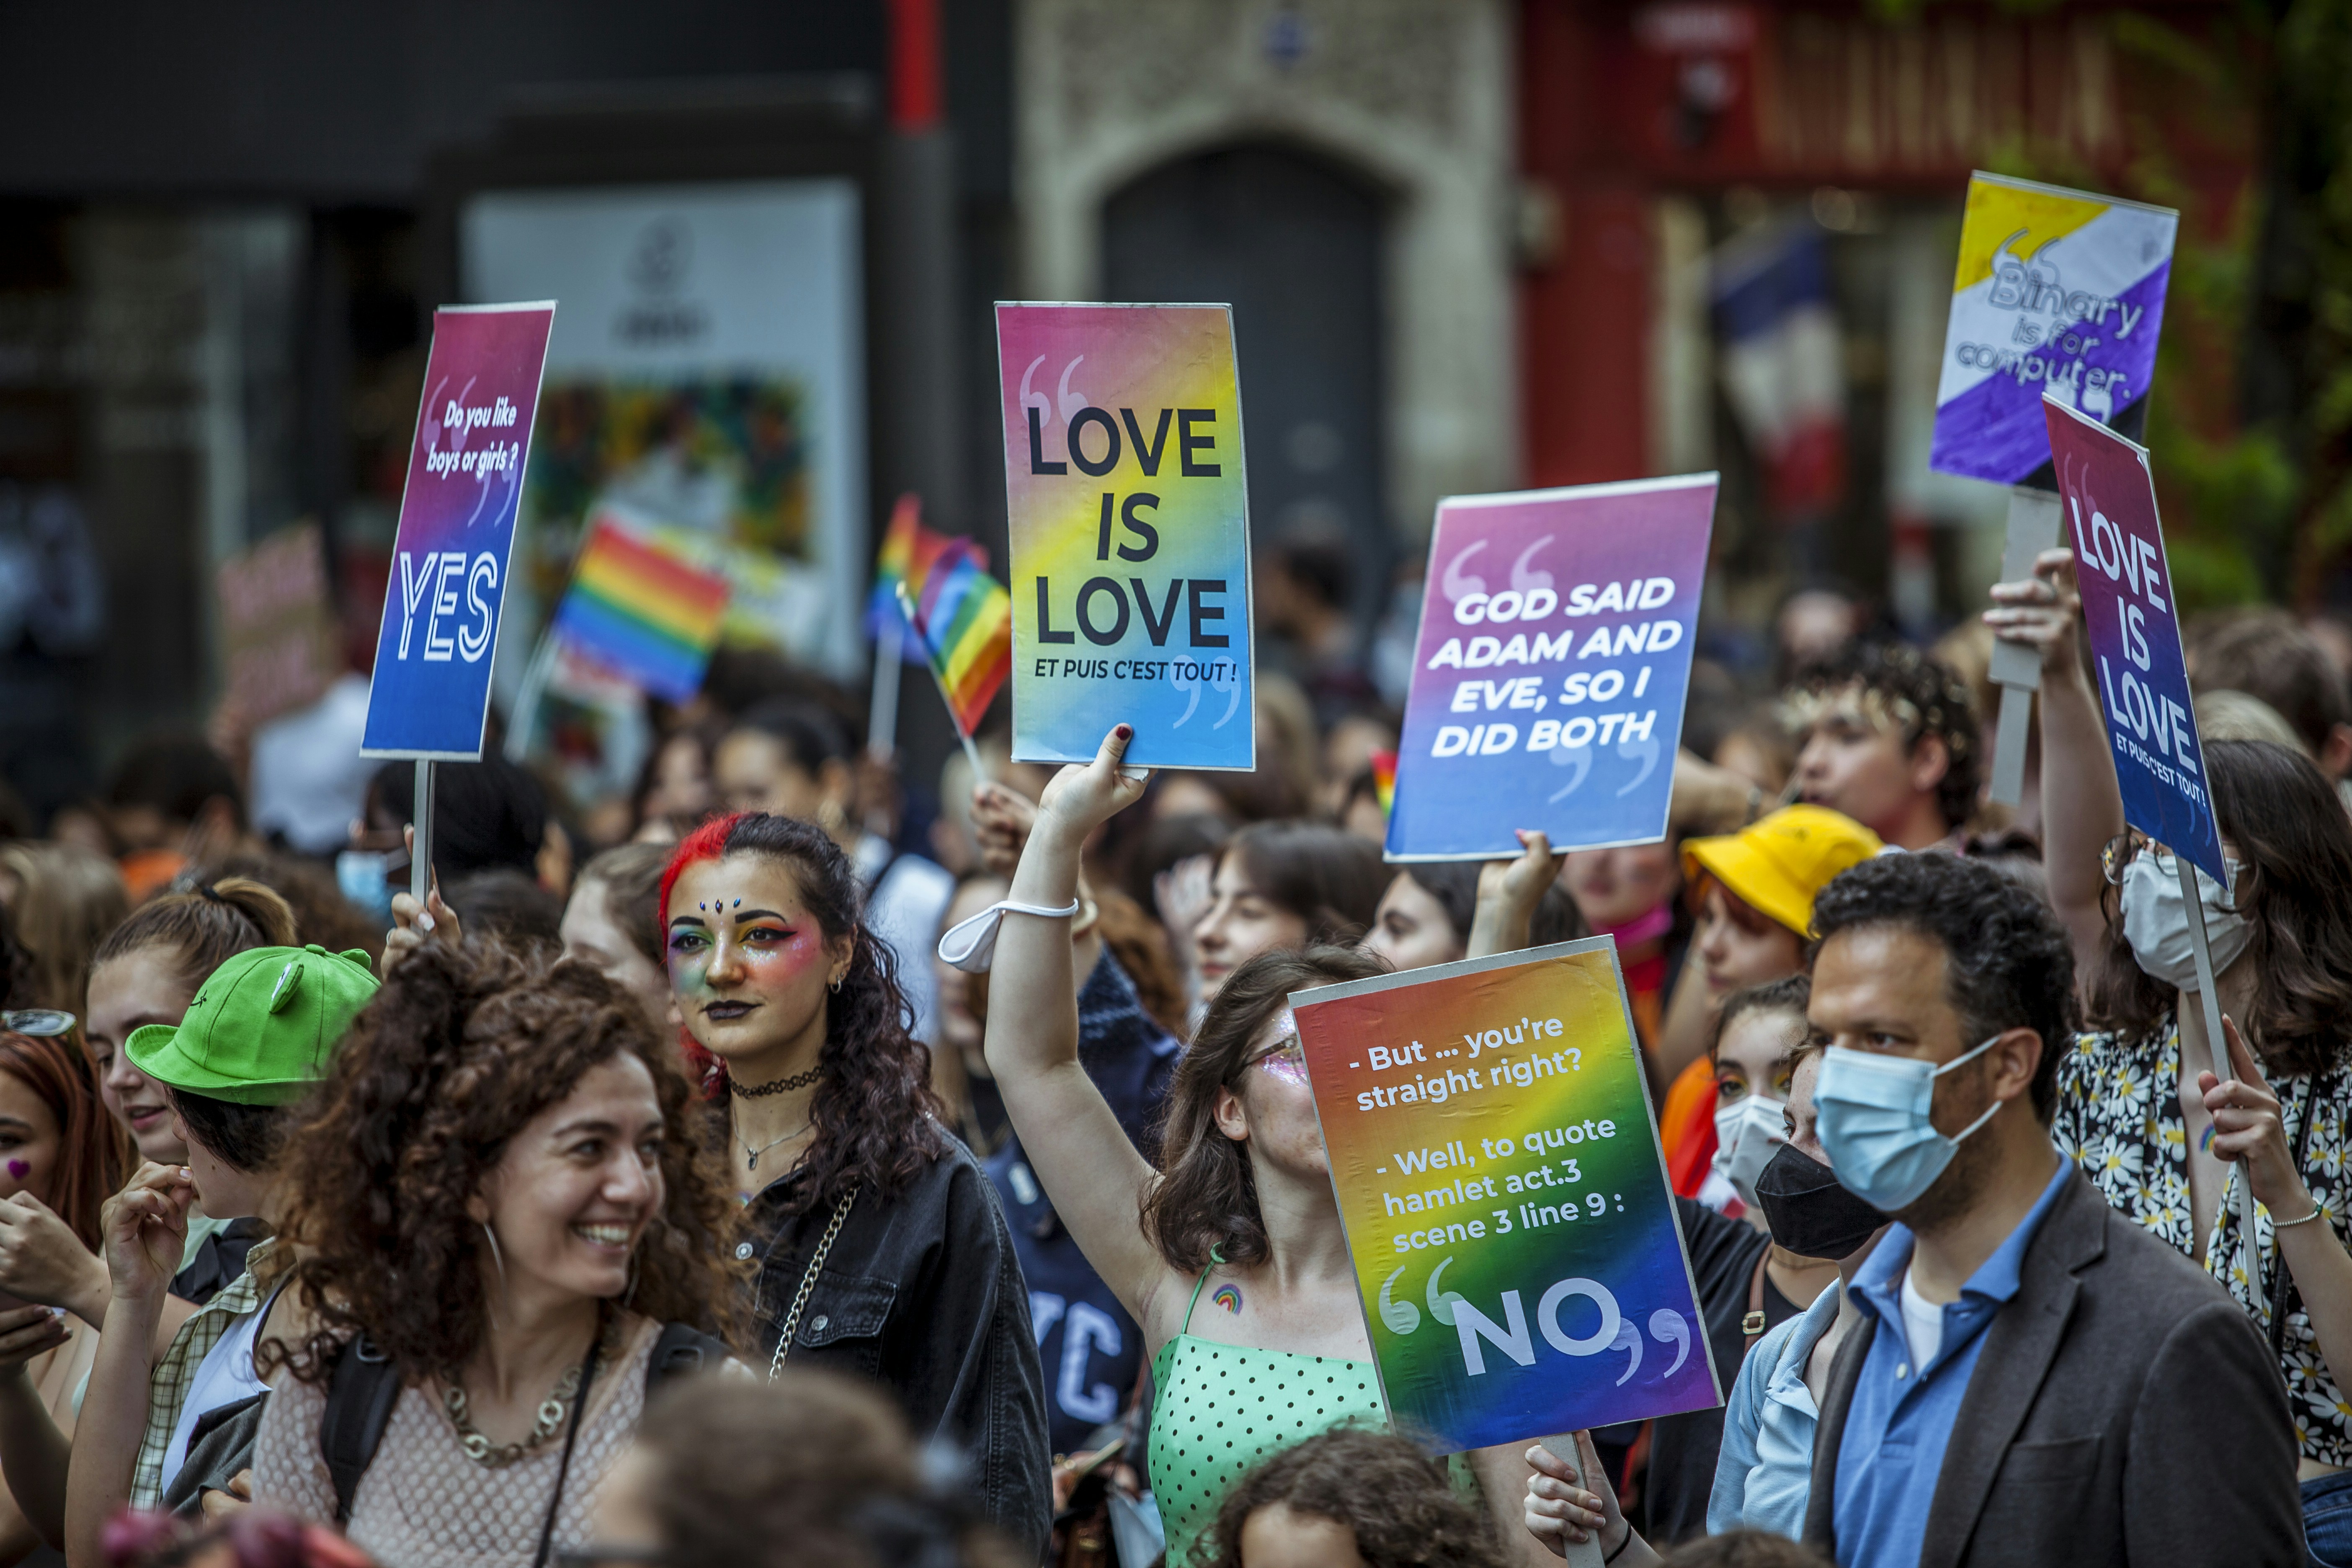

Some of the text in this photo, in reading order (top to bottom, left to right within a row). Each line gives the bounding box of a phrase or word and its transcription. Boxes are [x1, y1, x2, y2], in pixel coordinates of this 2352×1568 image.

[1988, 261, 2144, 340] Binary
[2011, 314, 2101, 357] is for
[444, 395, 517, 436] Do you like
[1028, 407, 1221, 477] LOVE
[426, 441, 461, 481] boys
[462, 450, 478, 472] or
[1096, 493, 1161, 563] IS
[2070, 497, 2166, 613] LOVE
[398, 551, 498, 663] YES
[1036, 575, 1230, 648] LOVE
[1454, 577, 1675, 625] GOD SAID
[1427, 620, 1683, 670] ADAM AND
[2117, 595, 2150, 671] IS
[1035, 659, 1059, 677] ET
[1063, 660, 1108, 678] PUIS
[1114, 660, 1168, 680] C'EST
[1450, 666, 1652, 713] EVE, SO I
[1431, 710, 1657, 757] DID BOTH
[2101, 655, 2197, 775] LOVE
[2116, 731, 2128, 753] ET
[2128, 740, 2150, 769] PUIS
[2149, 756, 2174, 787] C'EST
[1368, 1041, 1427, 1071] But
[1464, 1018, 1563, 1058] you're
[1357, 1048, 1582, 1111] straight right?
[1394, 1141, 1475, 1175] Well,
[1481, 1138, 1515, 1159] to
[1524, 1119, 1616, 1156] quote
[1383, 1159, 1581, 1217] hamlet act.3
[1393, 1220, 1486, 1253] scene
[1492, 1210, 1512, 1234] 3
[1519, 1202, 1579, 1229] line
[1586, 1193, 1606, 1216] 9
[1451, 1277, 1621, 1376] NO
